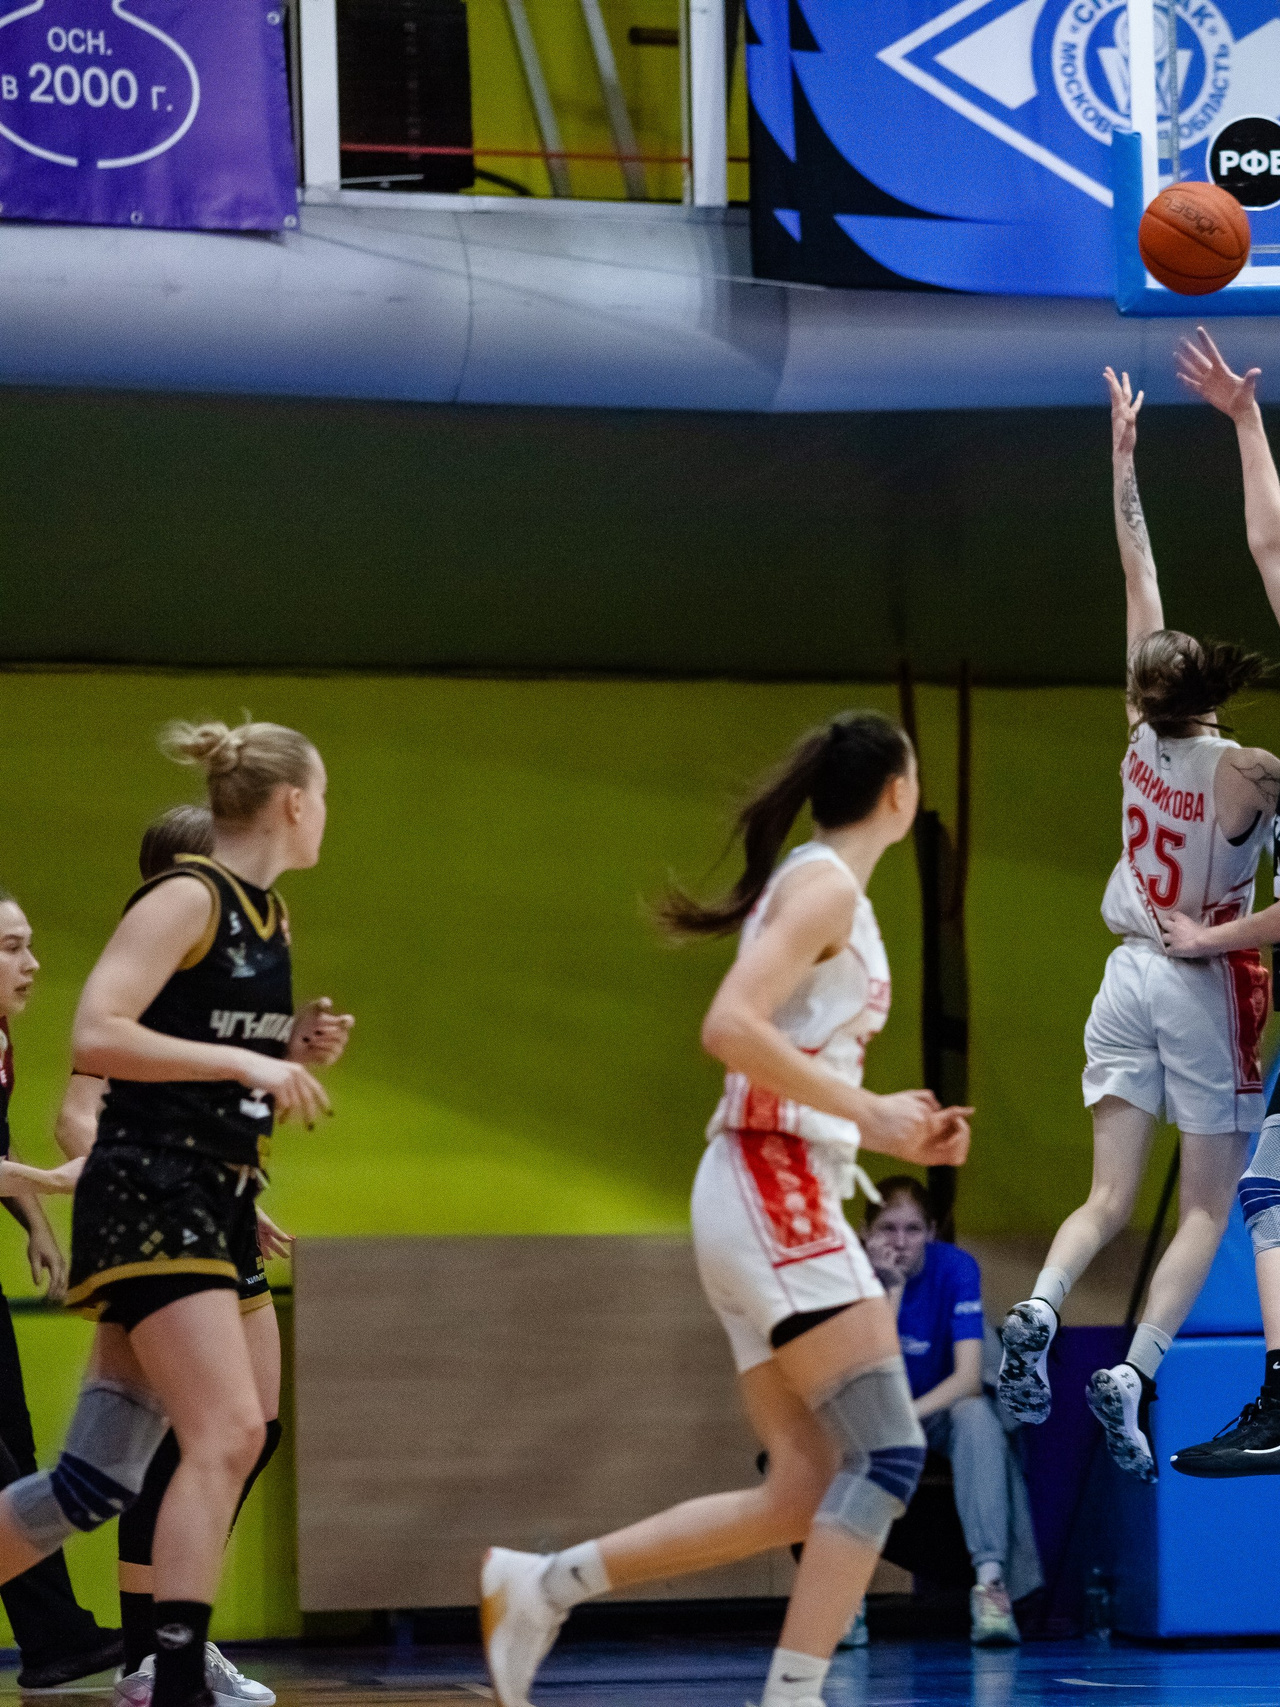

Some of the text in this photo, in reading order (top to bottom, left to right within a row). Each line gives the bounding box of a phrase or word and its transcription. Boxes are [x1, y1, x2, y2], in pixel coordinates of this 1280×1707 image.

[47, 26, 113, 56] ОСН.
[28, 62, 138, 110] 2000
[1178, 43, 1230, 139] ОБЛАСТЬ
[1127, 804, 1186, 910] 25
